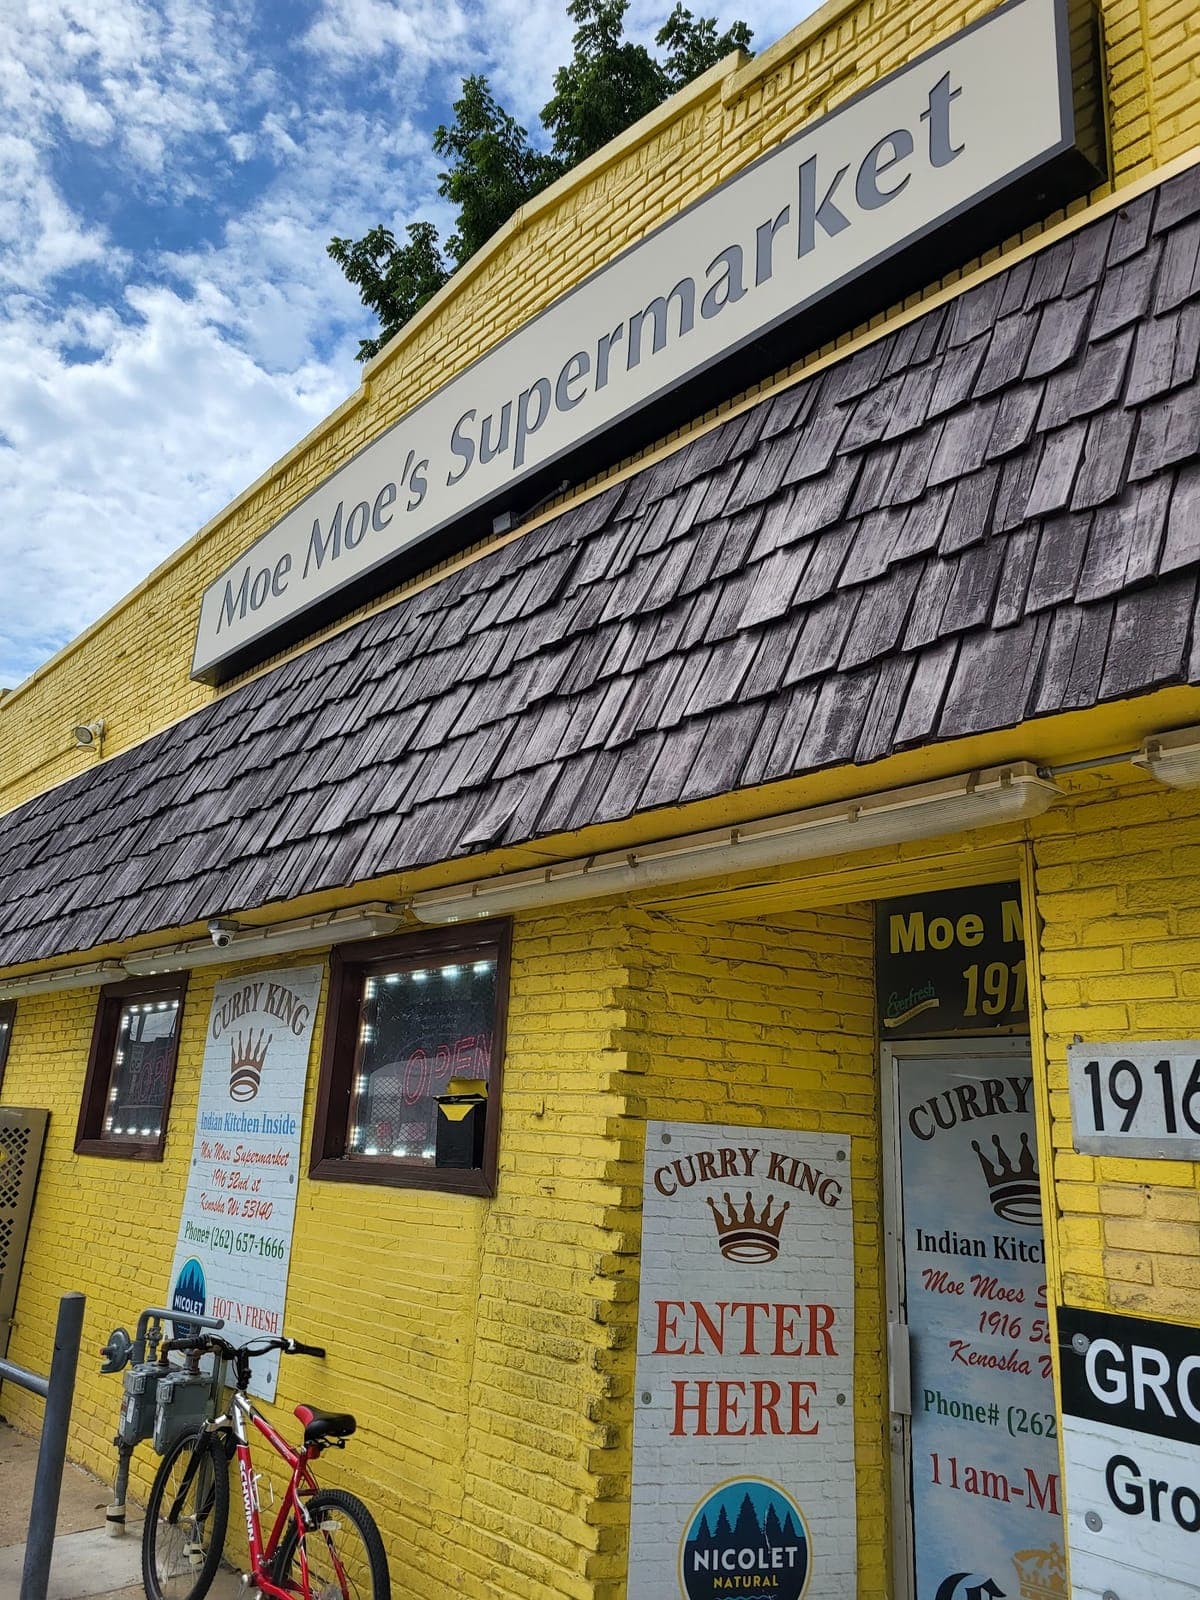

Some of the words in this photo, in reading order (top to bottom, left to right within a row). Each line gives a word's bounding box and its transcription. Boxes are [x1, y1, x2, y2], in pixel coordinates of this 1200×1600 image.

[216, 552, 292, 634] Moe
[302, 449, 430, 580] Moe's
[446, 70, 966, 487] Supermarket
[889, 911, 985, 954] Moe
[212, 982, 264, 1040] CURRY
[262, 982, 310, 1036] KING
[403, 1031, 494, 1106] OPEN
[908, 1077, 1033, 1141] CURRY
[1084, 1059, 1200, 1135] 1916
[200, 1111, 223, 1131] Indian
[223, 1112, 260, 1134] Kitchen
[261, 1113, 296, 1136] Inside
[233, 1144, 290, 1168] Supermarket
[211, 1168, 228, 1188] 1916
[227, 1171, 250, 1191] 52nd
[654, 1147, 761, 1197] CURRY
[766, 1151, 843, 1208] KING
[241, 1198, 273, 1221] 53140
[184, 1220, 211, 1244] Phone#
[210, 1226, 235, 1256] (262)
[235, 1231, 286, 1261] 657-1666
[916, 1228, 987, 1258] Indian
[921, 1268, 965, 1296] Moe
[970, 1274, 1026, 1303] Moes
[174, 1294, 204, 1316] NICOLET
[212, 1295, 235, 1322] HOT
[244, 1305, 279, 1334] FRESH
[651, 1300, 839, 1356] ENTER
[978, 1310, 1022, 1339] 1916
[949, 1339, 1032, 1376] Kenosha
[669, 1380, 820, 1436] HERE
[923, 1388, 1000, 1426] Phone#
[239, 1459, 255, 1542] SCHWINN
[693, 1546, 798, 1572] NICOLET
[713, 1574, 779, 1589] NATURAL
